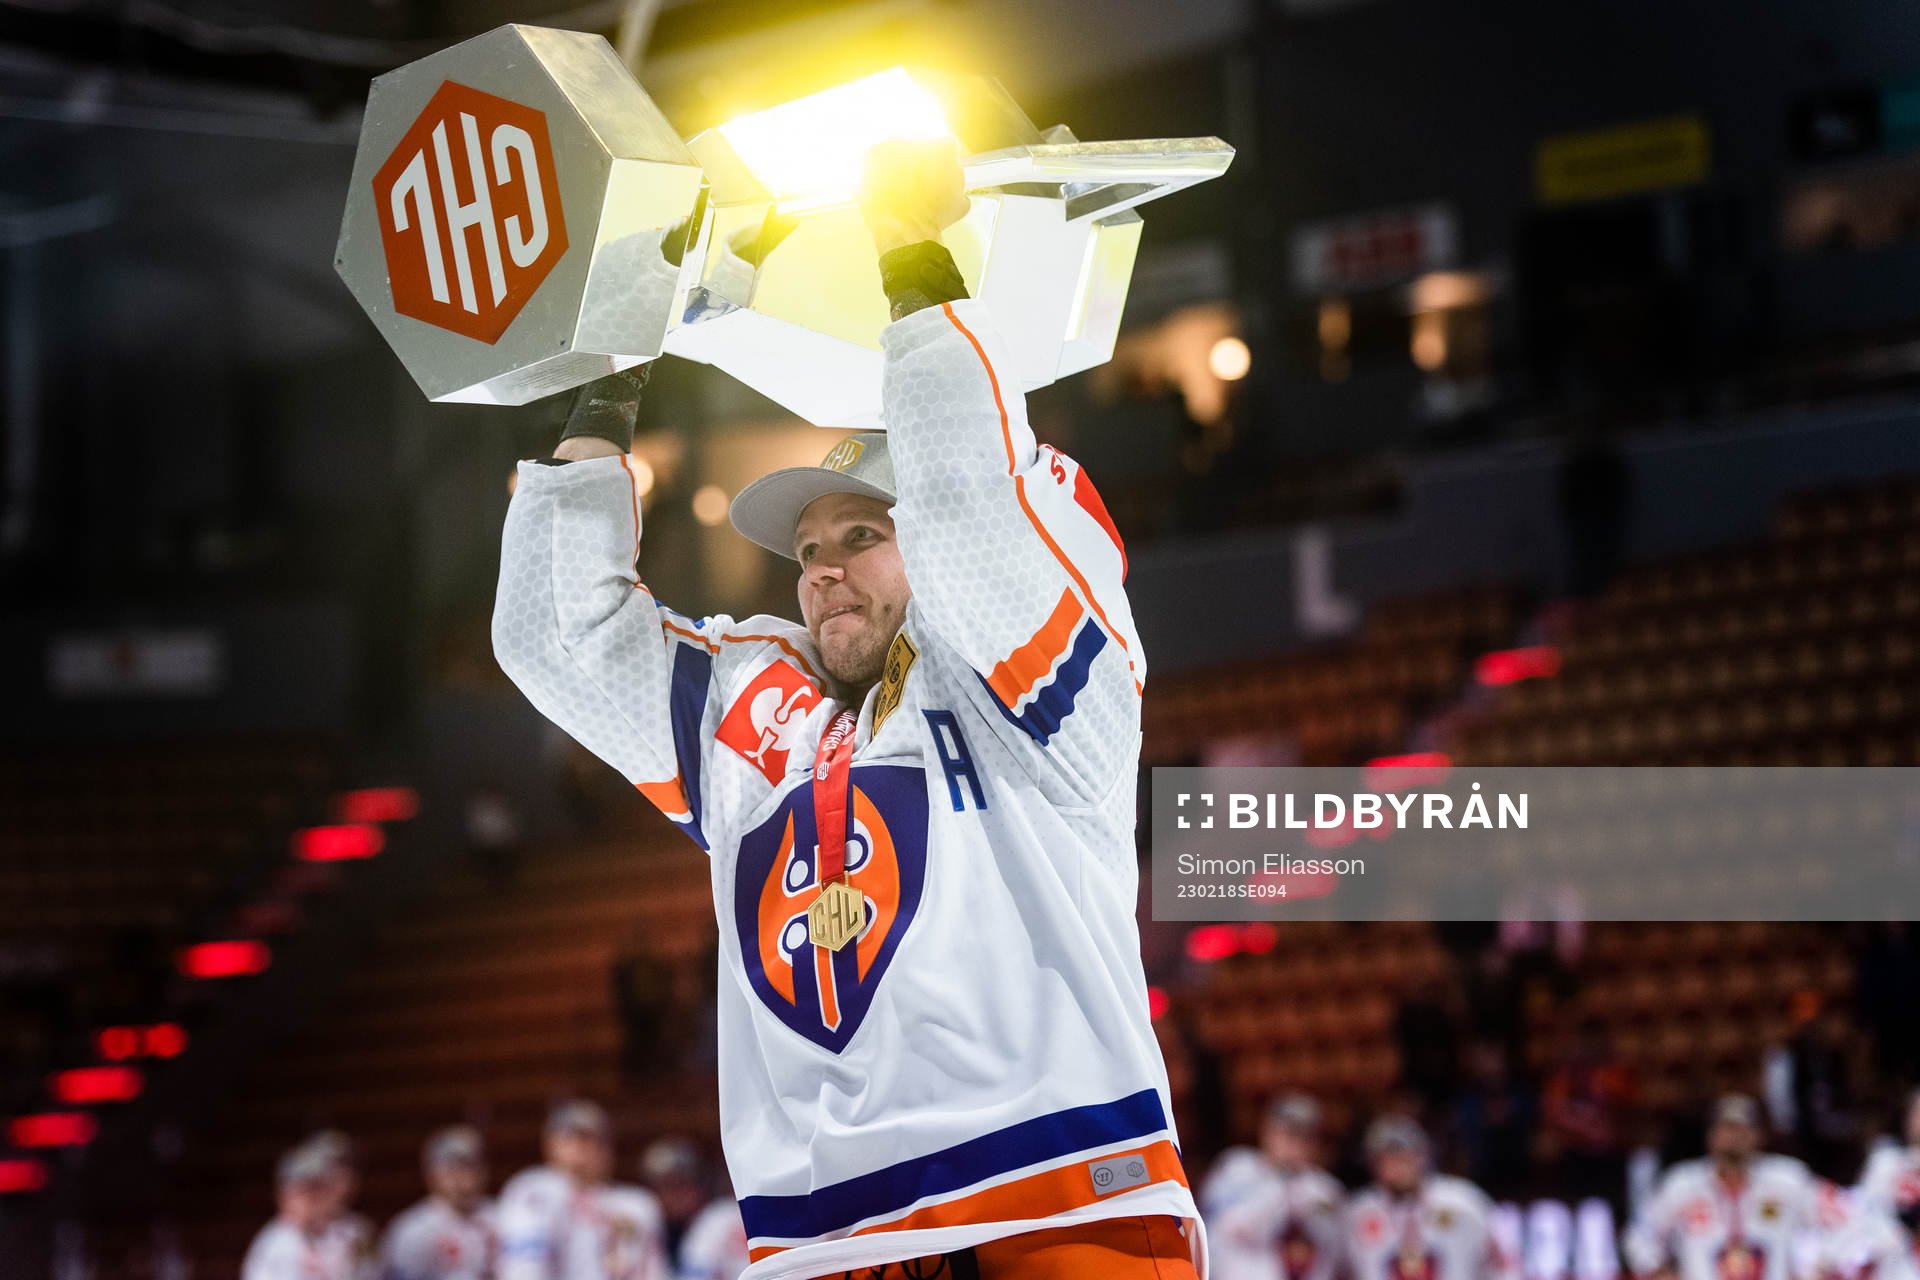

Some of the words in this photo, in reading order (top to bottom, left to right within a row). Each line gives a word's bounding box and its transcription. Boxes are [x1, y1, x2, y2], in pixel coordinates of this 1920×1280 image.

[391, 111, 549, 315] CHL
[921, 708, 988, 812] A
[812, 890, 858, 944] CHL
